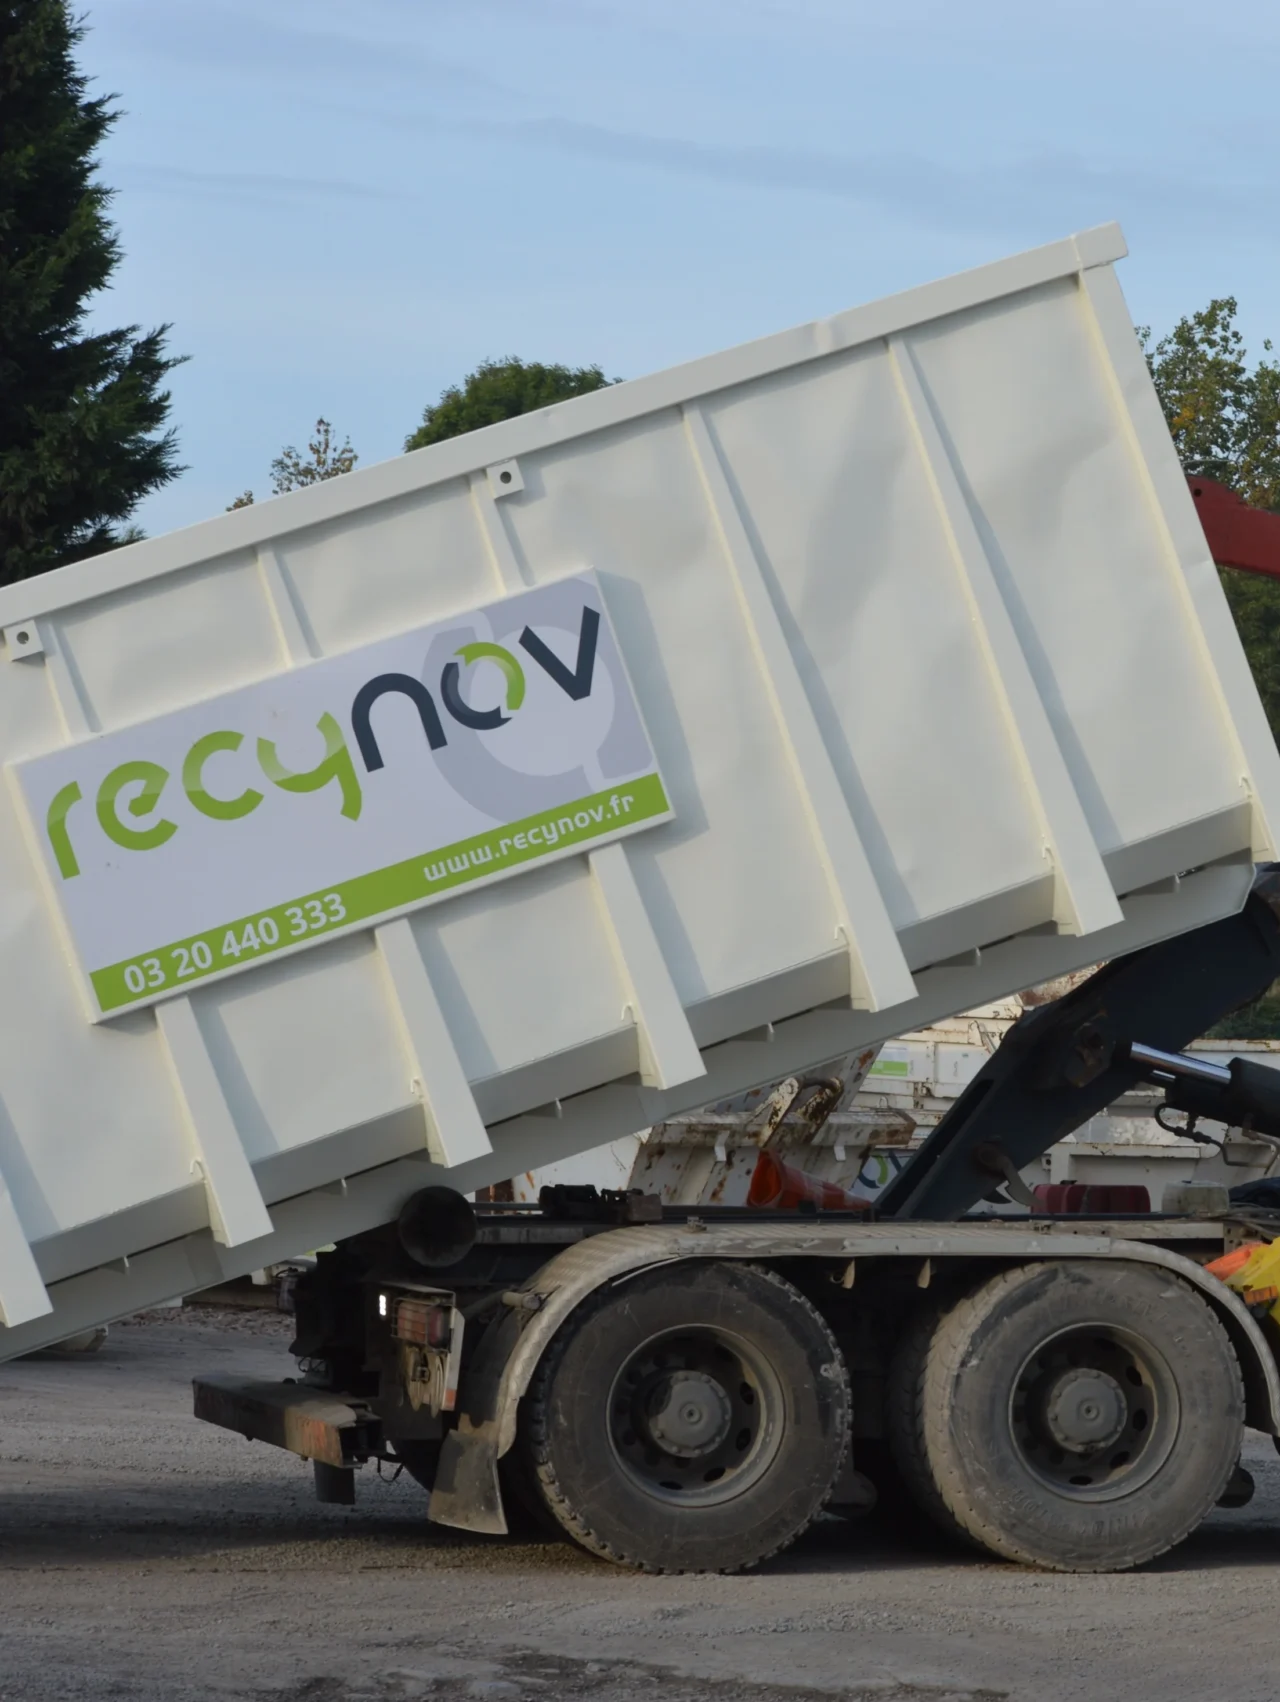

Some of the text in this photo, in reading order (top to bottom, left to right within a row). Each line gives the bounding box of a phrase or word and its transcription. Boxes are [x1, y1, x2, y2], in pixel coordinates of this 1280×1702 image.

[46, 605, 601, 881] recynov
[423, 794, 634, 882] www.recynov.fr
[123, 892, 347, 994] 03 20 440 333
